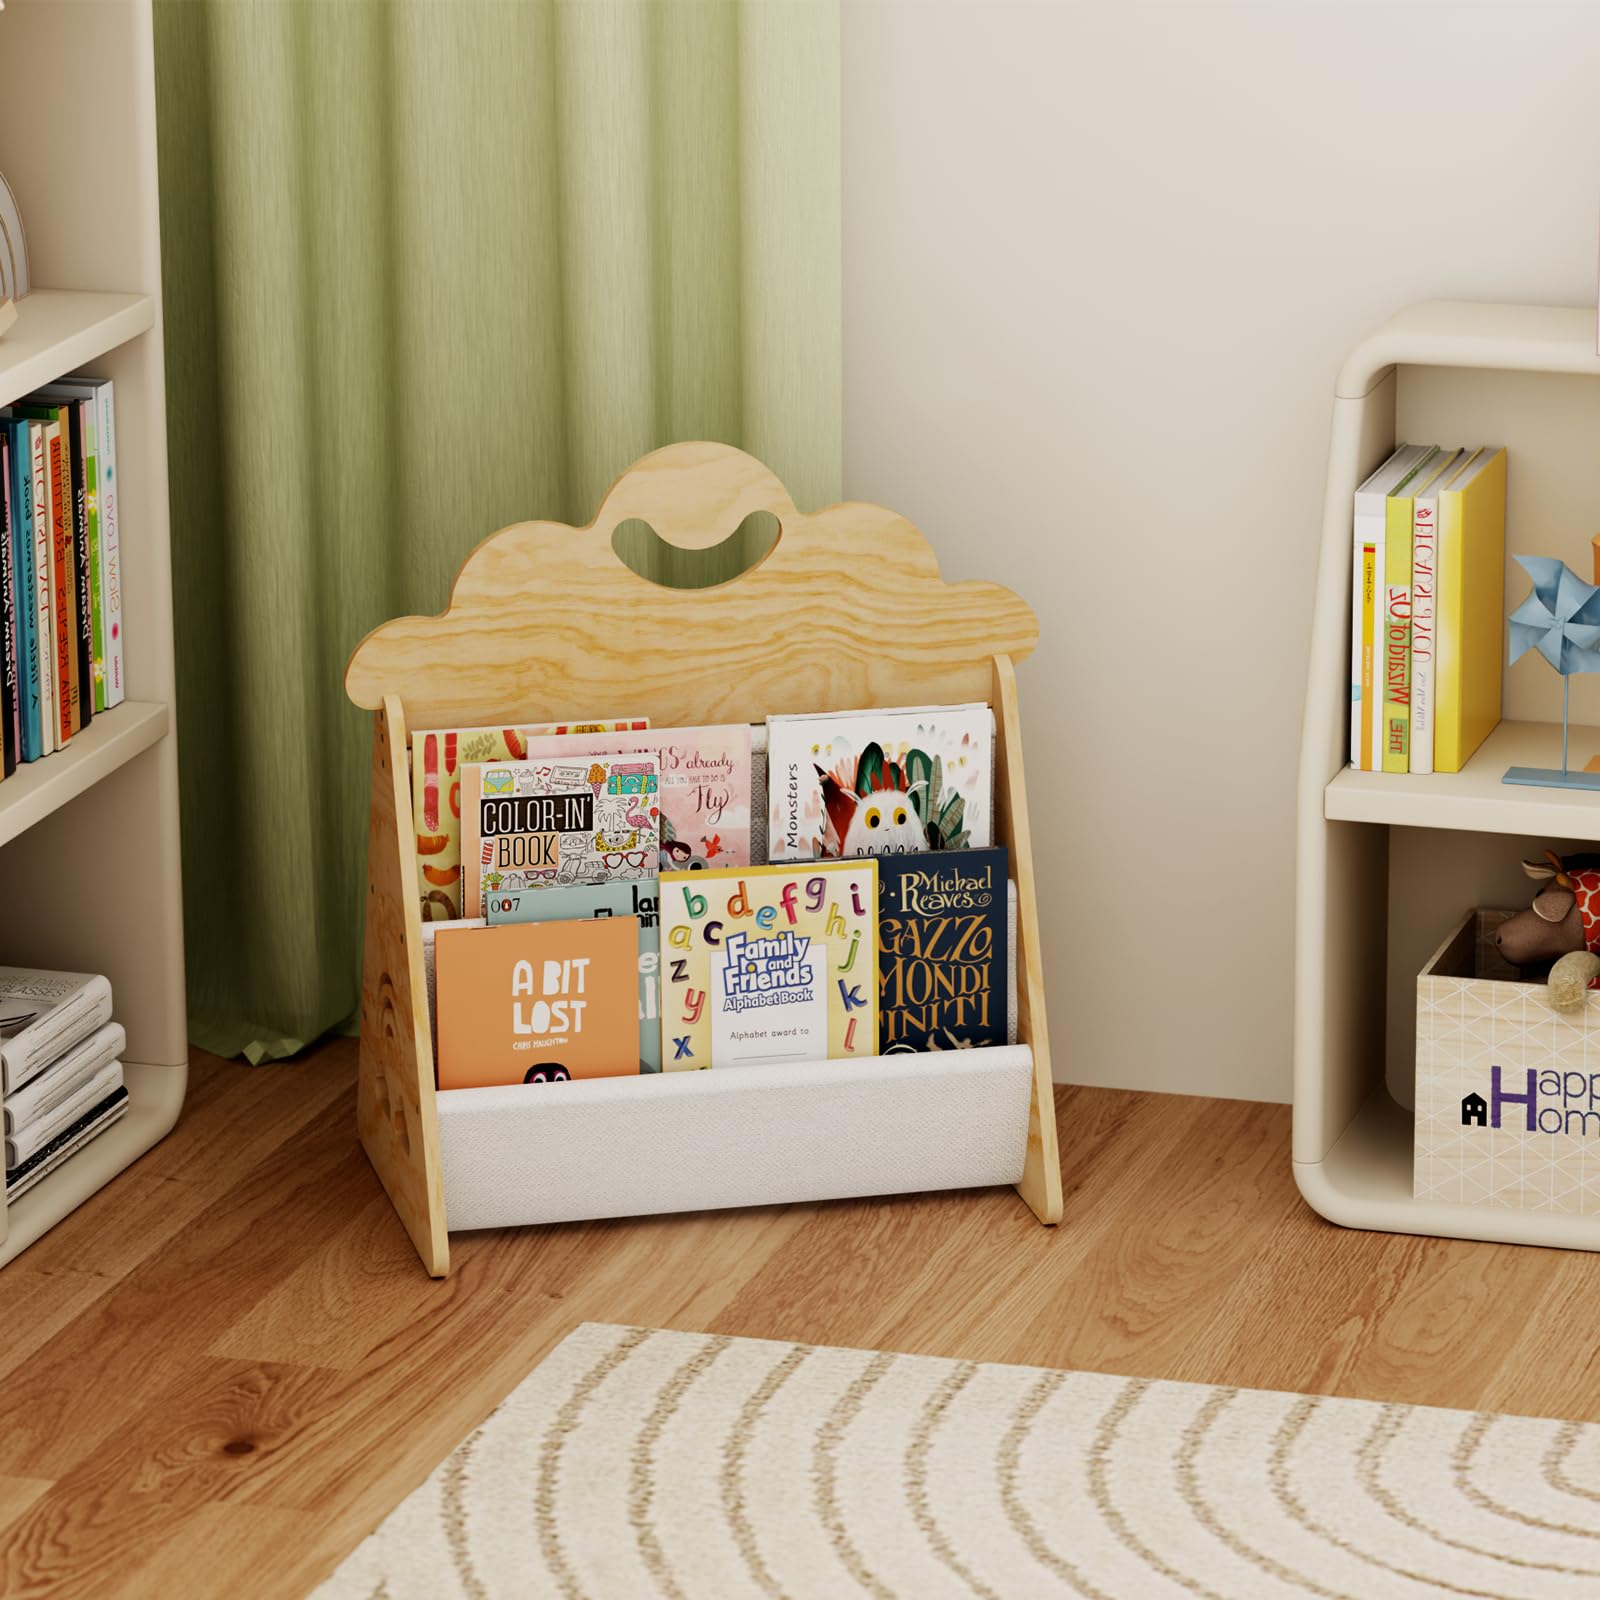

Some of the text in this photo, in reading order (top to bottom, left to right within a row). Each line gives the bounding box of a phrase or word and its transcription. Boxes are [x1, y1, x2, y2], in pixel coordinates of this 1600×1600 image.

[686, 751, 734, 774] already
[688, 784, 732, 825] Fly
[787, 763, 798, 848] Monsters
[498, 835, 556, 868] BOOK
[805, 877, 827, 913] g
[897, 872, 993, 917] Reaves
[917, 865, 992, 893] Michael
[490, 898, 521, 914] 007
[682, 886, 708, 920] b
[727, 880, 753, 918] d
[780, 882, 798, 925] f
[850, 883, 866, 916] i
[703, 921, 723, 945] c
[756, 906, 777, 930] e
[825, 903, 847, 939] h
[669, 924, 692, 951] a
[725, 931, 811, 967] Family
[838, 929, 861, 973] j
[512, 958, 590, 996] A BIT
[670, 959, 690, 983] z
[723, 960, 813, 996] Friends
[768, 956, 794, 971] and
[682, 987, 706, 1024] y
[723, 988, 814, 1013] Alphabet Book
[838, 979, 868, 1012] k
[513, 1000, 587, 1034] LOST
[879, 990, 991, 1043] INITI
[672, 1035, 694, 1060] x
[730, 1030, 767, 1042] Alphabet
[771, 1028, 797, 1037] award
[844, 1018, 857, 1052] l
